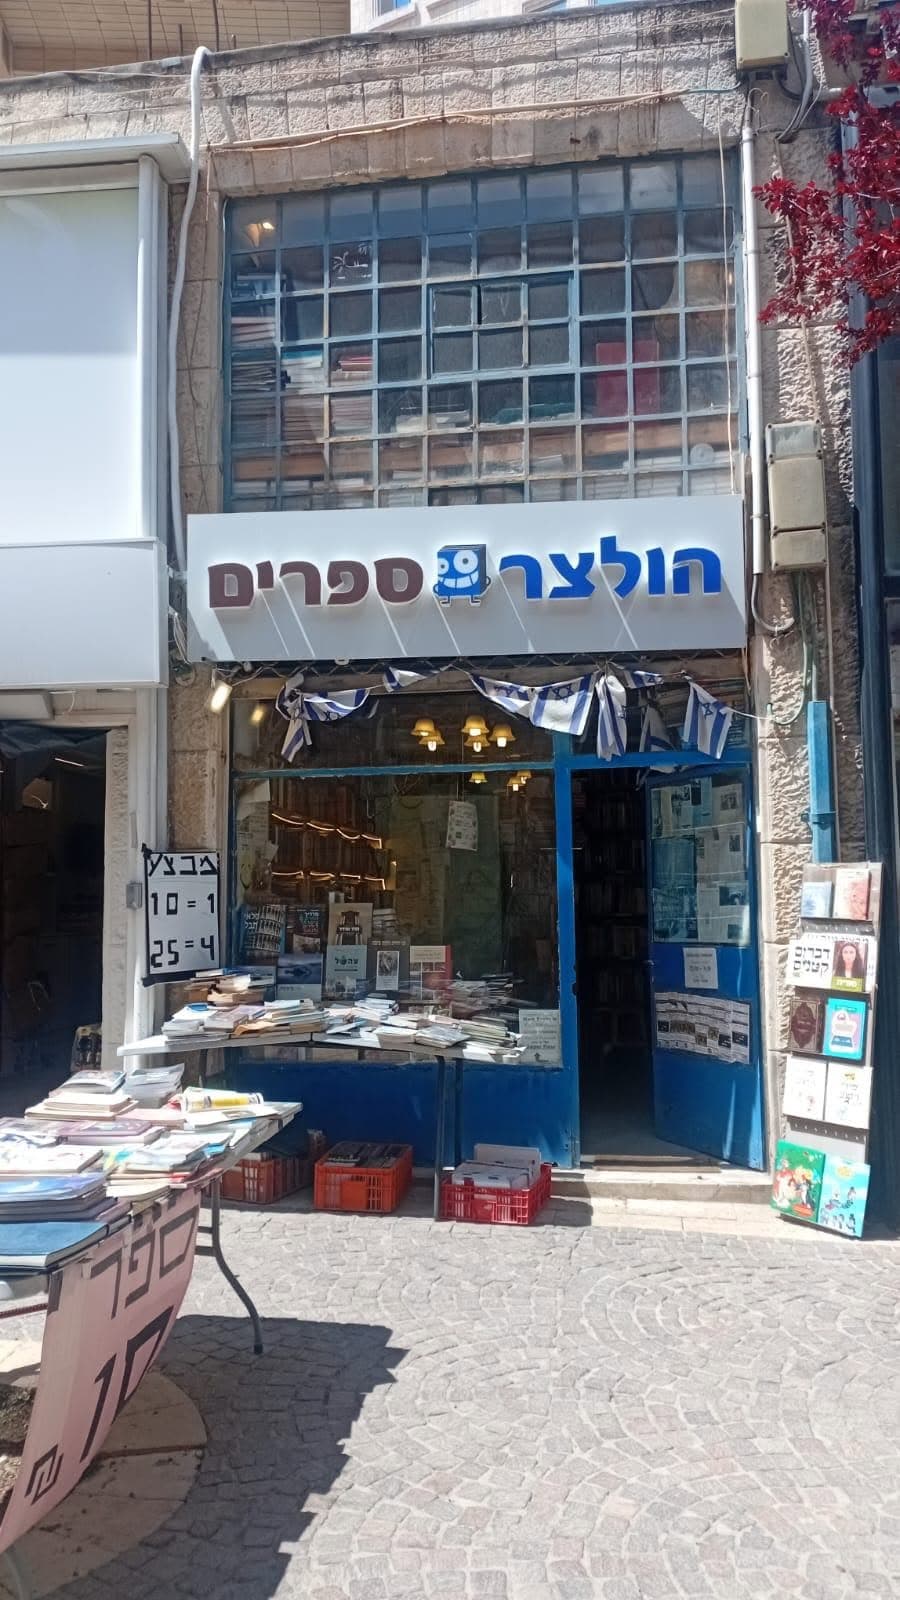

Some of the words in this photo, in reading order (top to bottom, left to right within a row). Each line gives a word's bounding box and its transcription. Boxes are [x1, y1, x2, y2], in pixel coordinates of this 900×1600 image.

[499, 535, 722, 600] הולצר
[208, 557, 424, 609] ספרים
[147, 854, 218, 876] מבצע
[151, 892, 178, 915] 10
[207, 893, 215, 914] 1
[151, 940, 179, 968] 25
[200, 935, 215, 961] 4
[795, 946, 831, 960] דברים
[793, 960, 829, 977] קטנים
